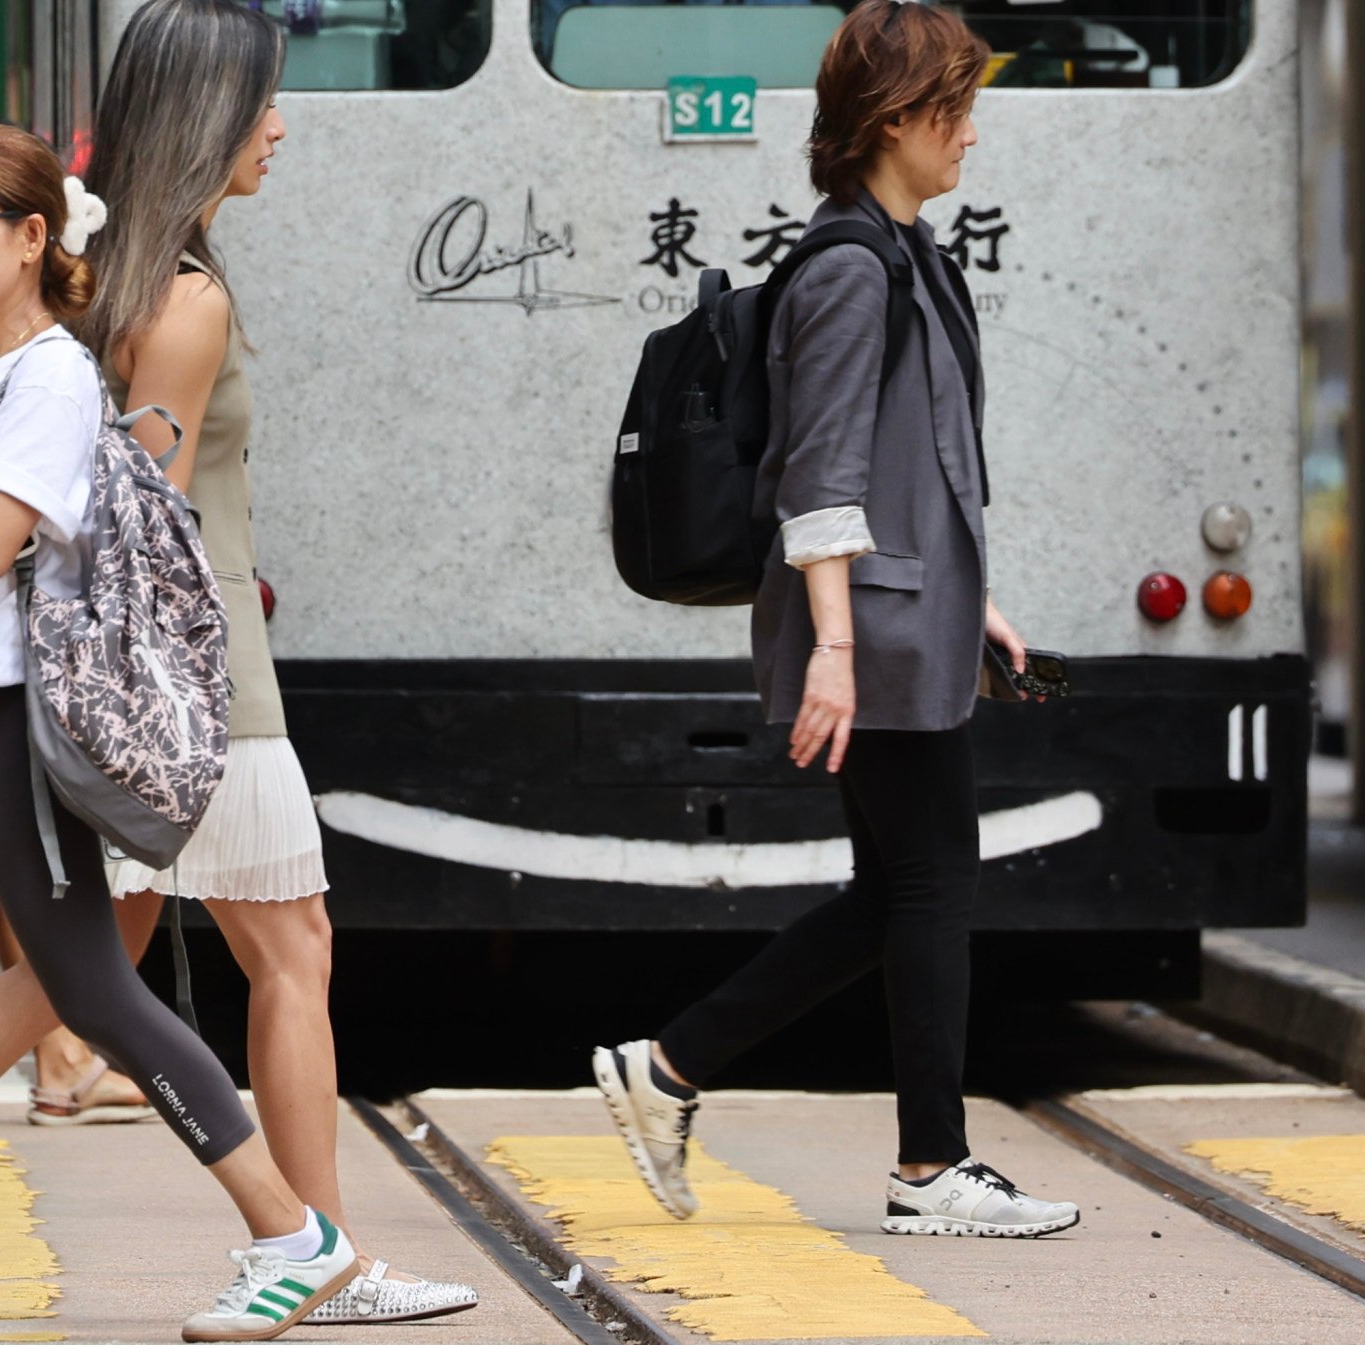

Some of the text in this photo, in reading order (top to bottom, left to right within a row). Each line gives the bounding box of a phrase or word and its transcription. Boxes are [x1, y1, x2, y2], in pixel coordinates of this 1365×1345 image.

[674, 90, 751, 127] S12
[639, 197, 1011, 278] 東方行
[1228, 703, 1268, 782] 11
[152, 1073, 210, 1146] LORNA JANE
